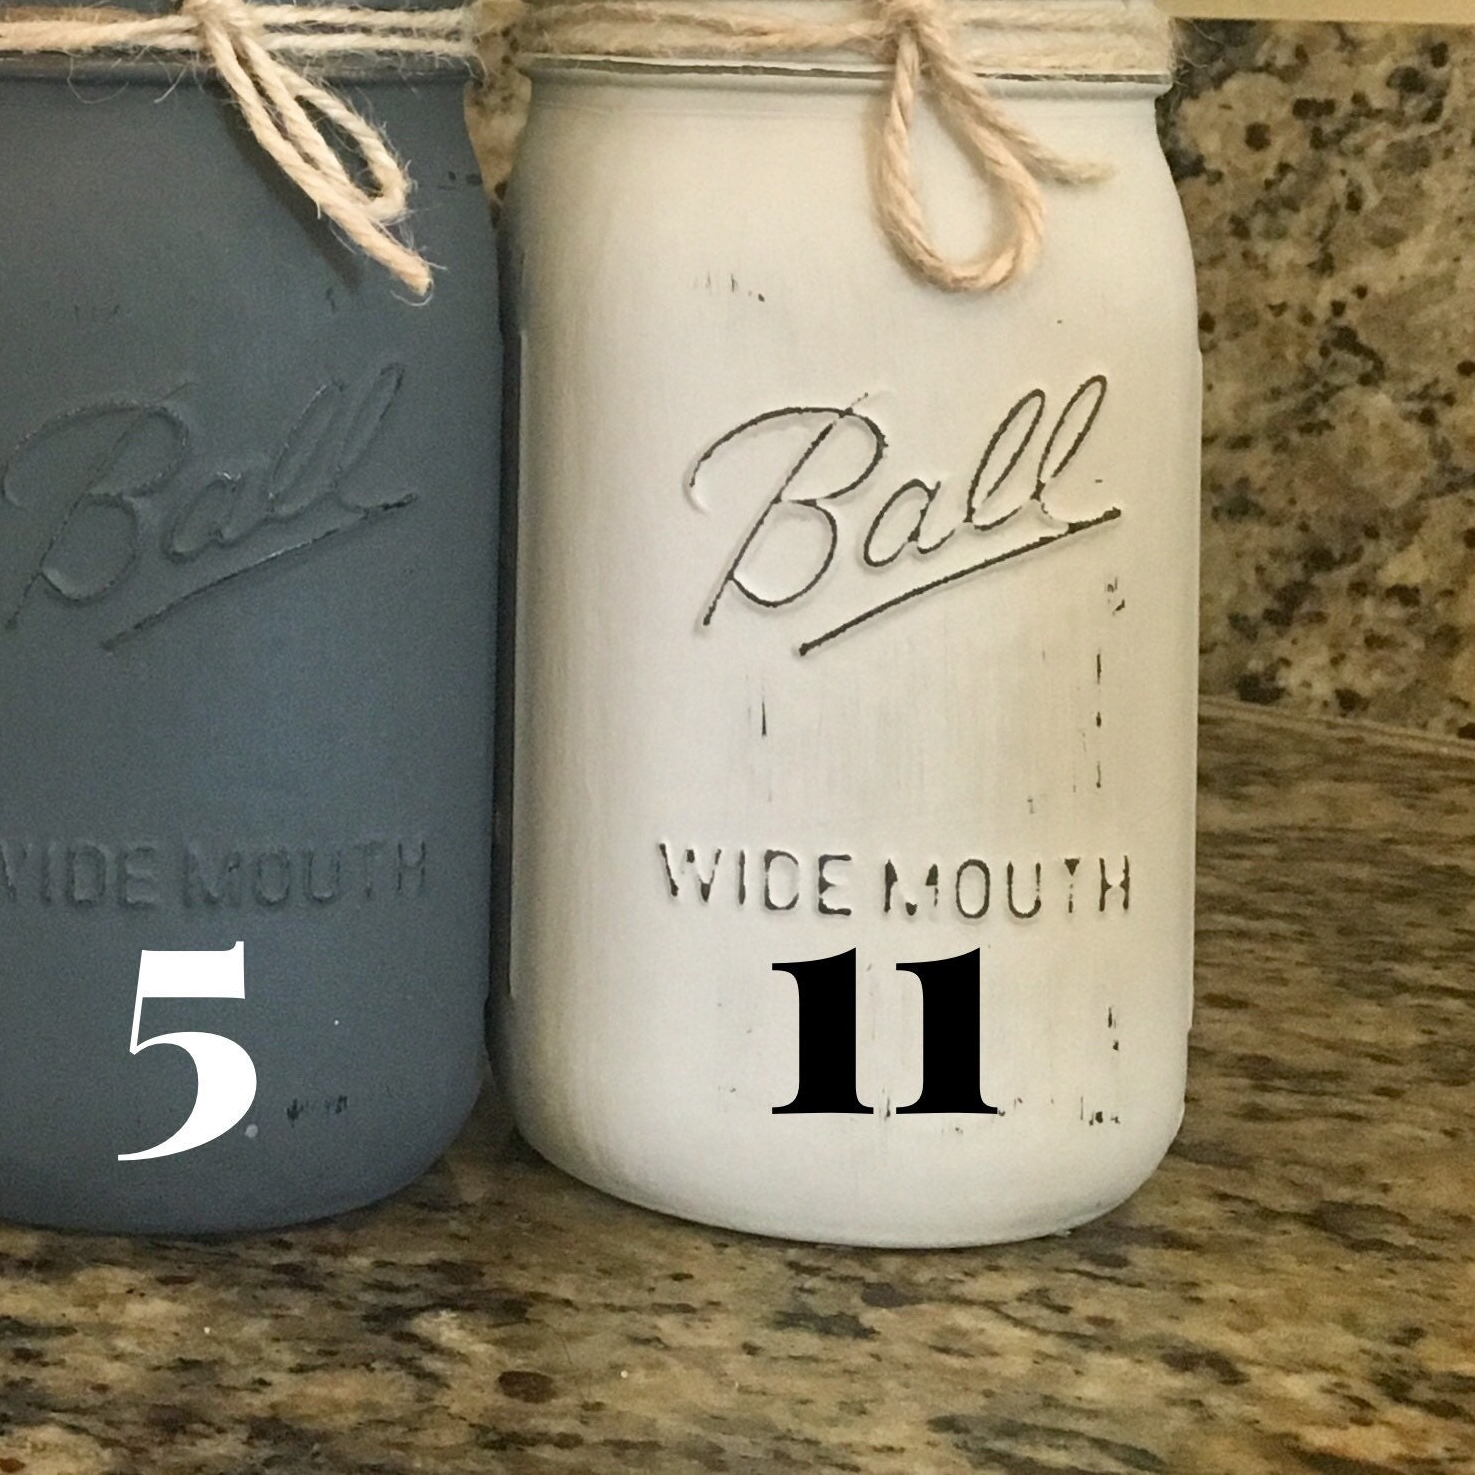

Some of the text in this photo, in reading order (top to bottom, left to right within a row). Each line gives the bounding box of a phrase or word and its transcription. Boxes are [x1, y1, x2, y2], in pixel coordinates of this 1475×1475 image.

[0, 362, 418, 629] Ball
[686, 375, 1122, 628] Ball
[183, 839, 426, 908] MOUTH
[658, 842, 1131, 919] WIDE MOUTH
